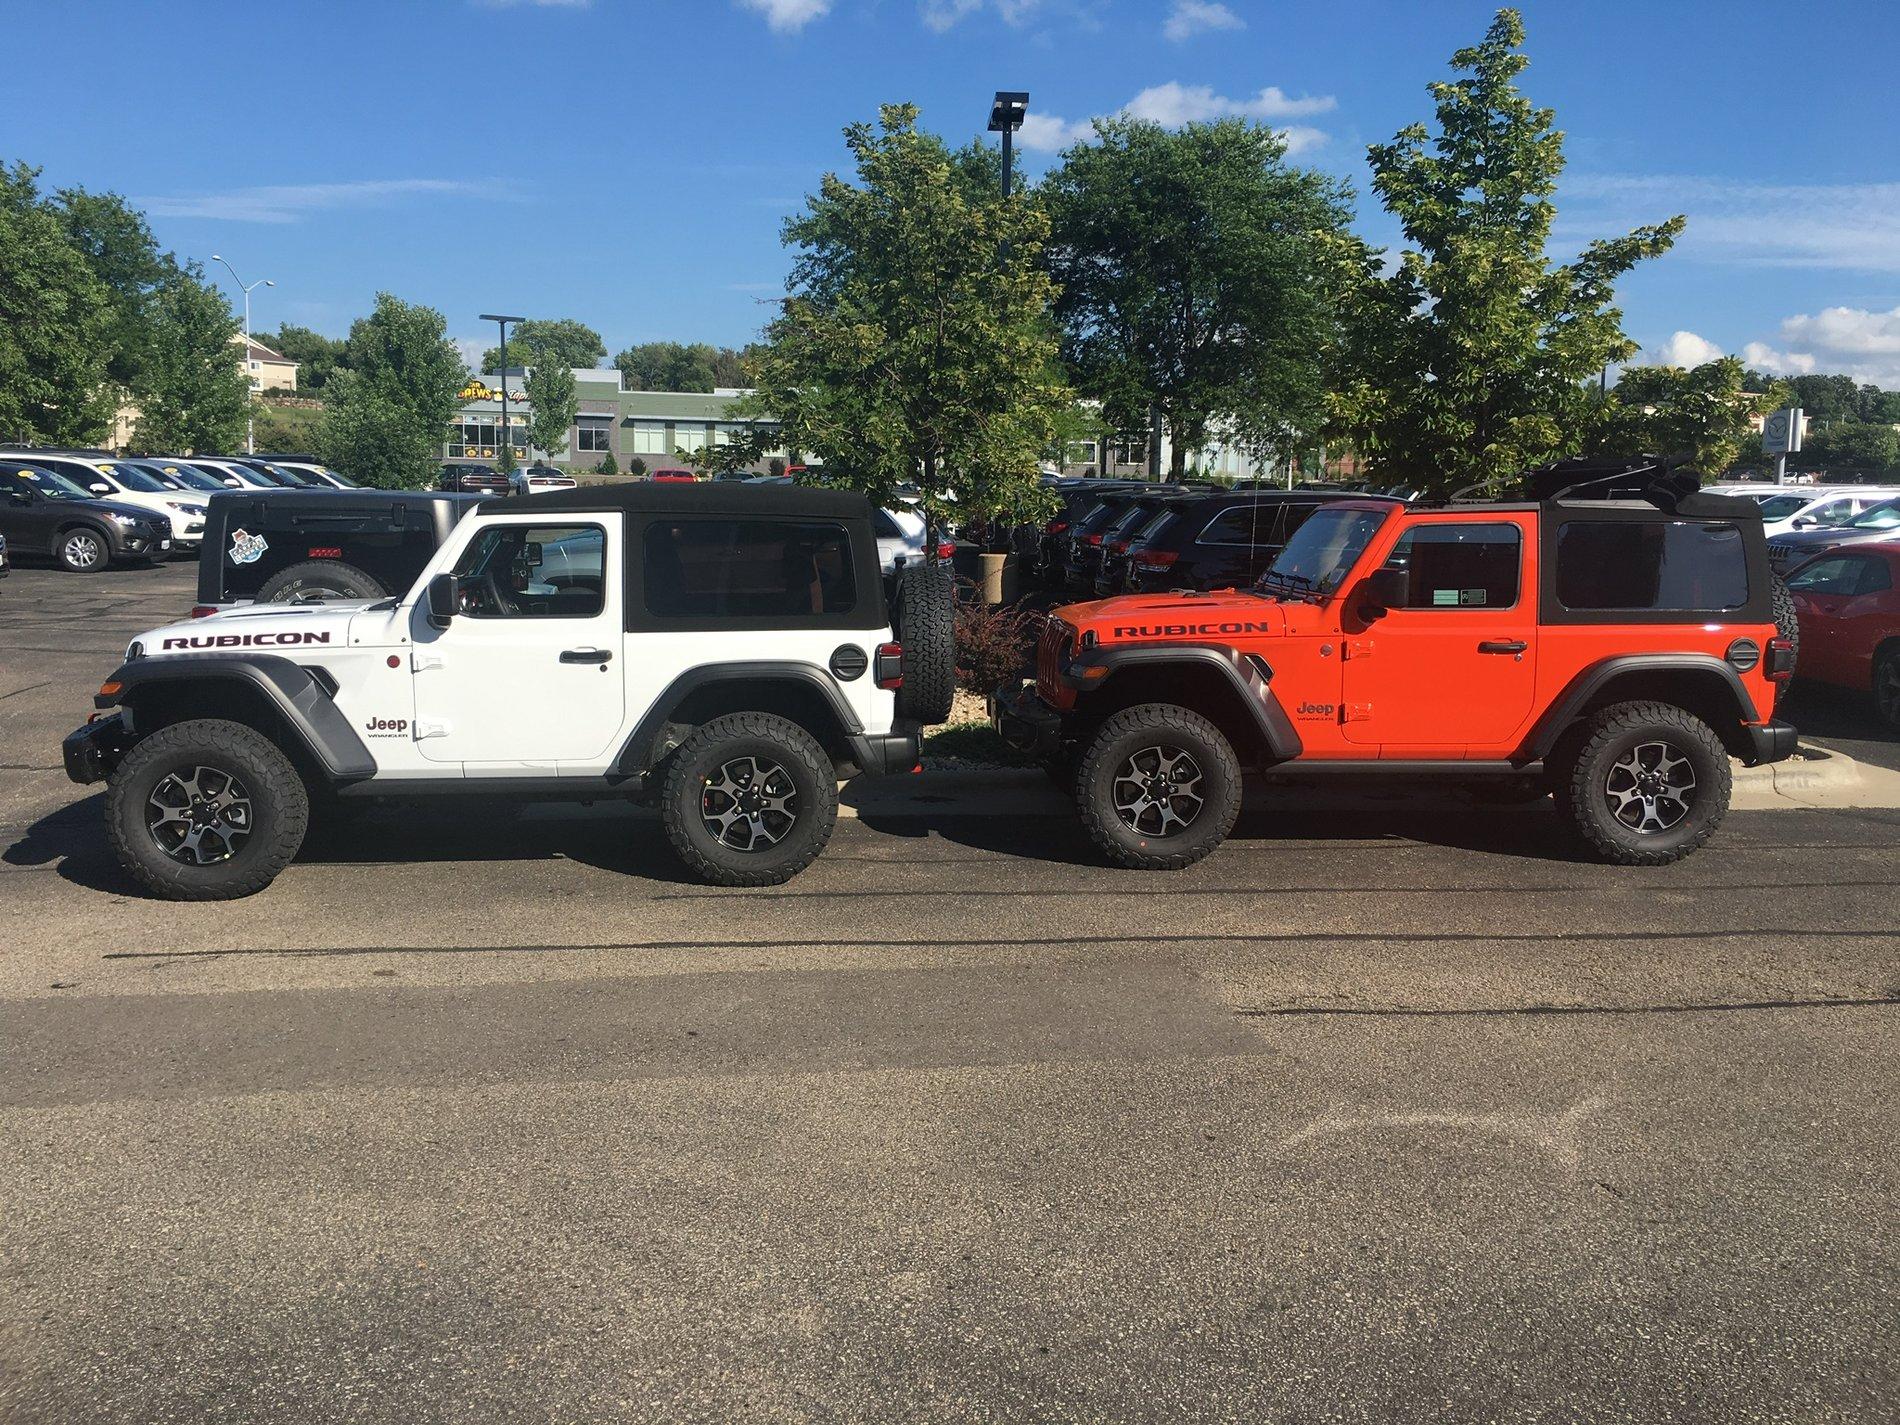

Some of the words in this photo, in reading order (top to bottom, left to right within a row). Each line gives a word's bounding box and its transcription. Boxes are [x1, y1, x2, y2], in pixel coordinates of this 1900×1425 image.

[1113, 621, 1268, 637] RUBICON
[163, 632, 330, 650] RUBICON
[1296, 702, 1334, 716] Jeep
[366, 716, 408, 732] Jeep
